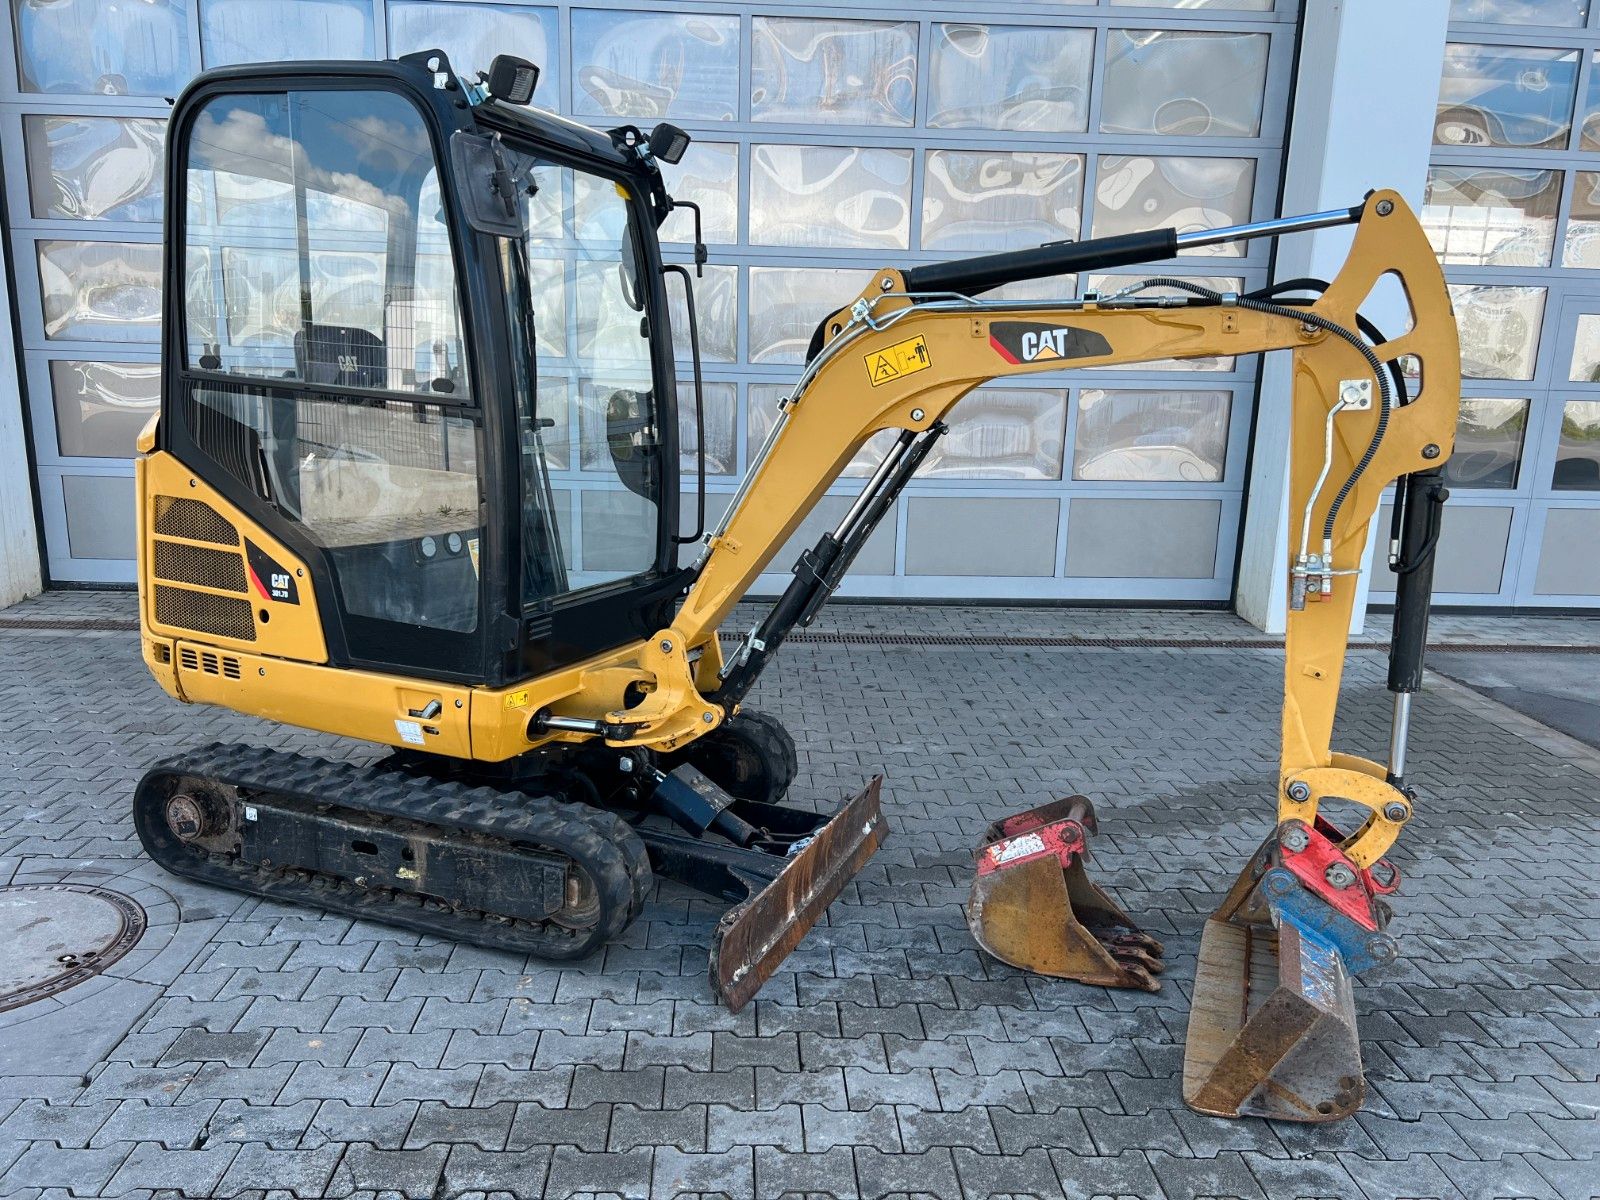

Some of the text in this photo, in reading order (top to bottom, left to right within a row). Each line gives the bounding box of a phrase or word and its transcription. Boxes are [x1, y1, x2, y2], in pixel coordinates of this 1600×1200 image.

[1022, 328, 1068, 361] CAT
[338, 355, 358, 372] CAT
[271, 573, 289, 589] CAT
